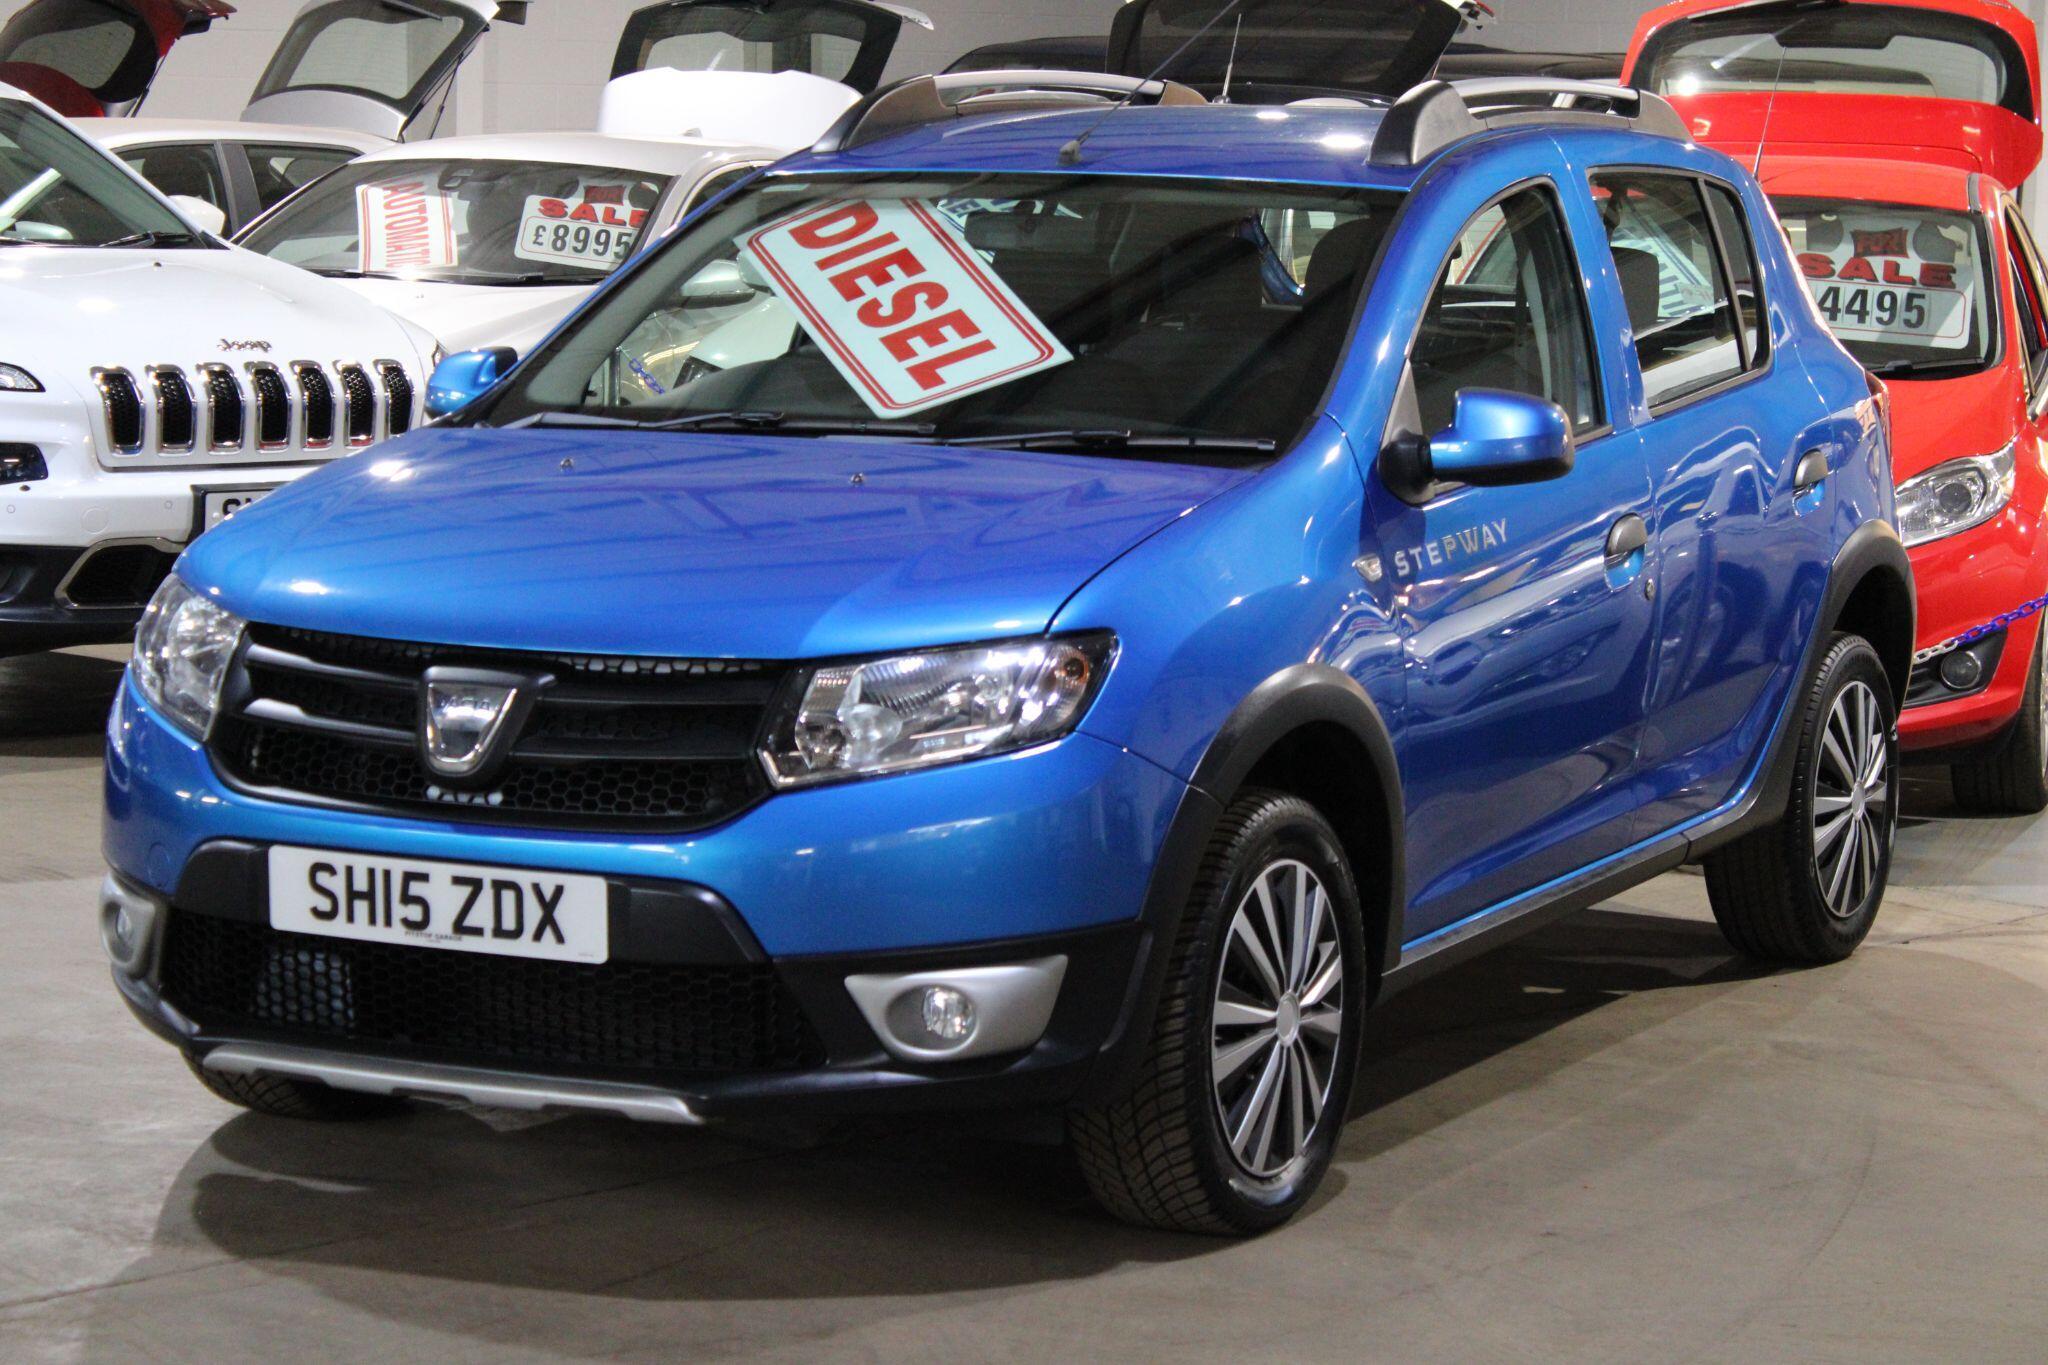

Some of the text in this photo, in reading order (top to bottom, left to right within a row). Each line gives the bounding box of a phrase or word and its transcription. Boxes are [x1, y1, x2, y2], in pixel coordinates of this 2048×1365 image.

[537, 198, 649, 228] SALE
[532, 223, 632, 260] £8995
[1796, 252, 1958, 289] SALE
[787, 199, 997, 391] DIESEL
[1816, 286, 1926, 329] 4495
[1394, 518, 1507, 577] STEPWAY
[451, 875, 566, 945] ZDX
